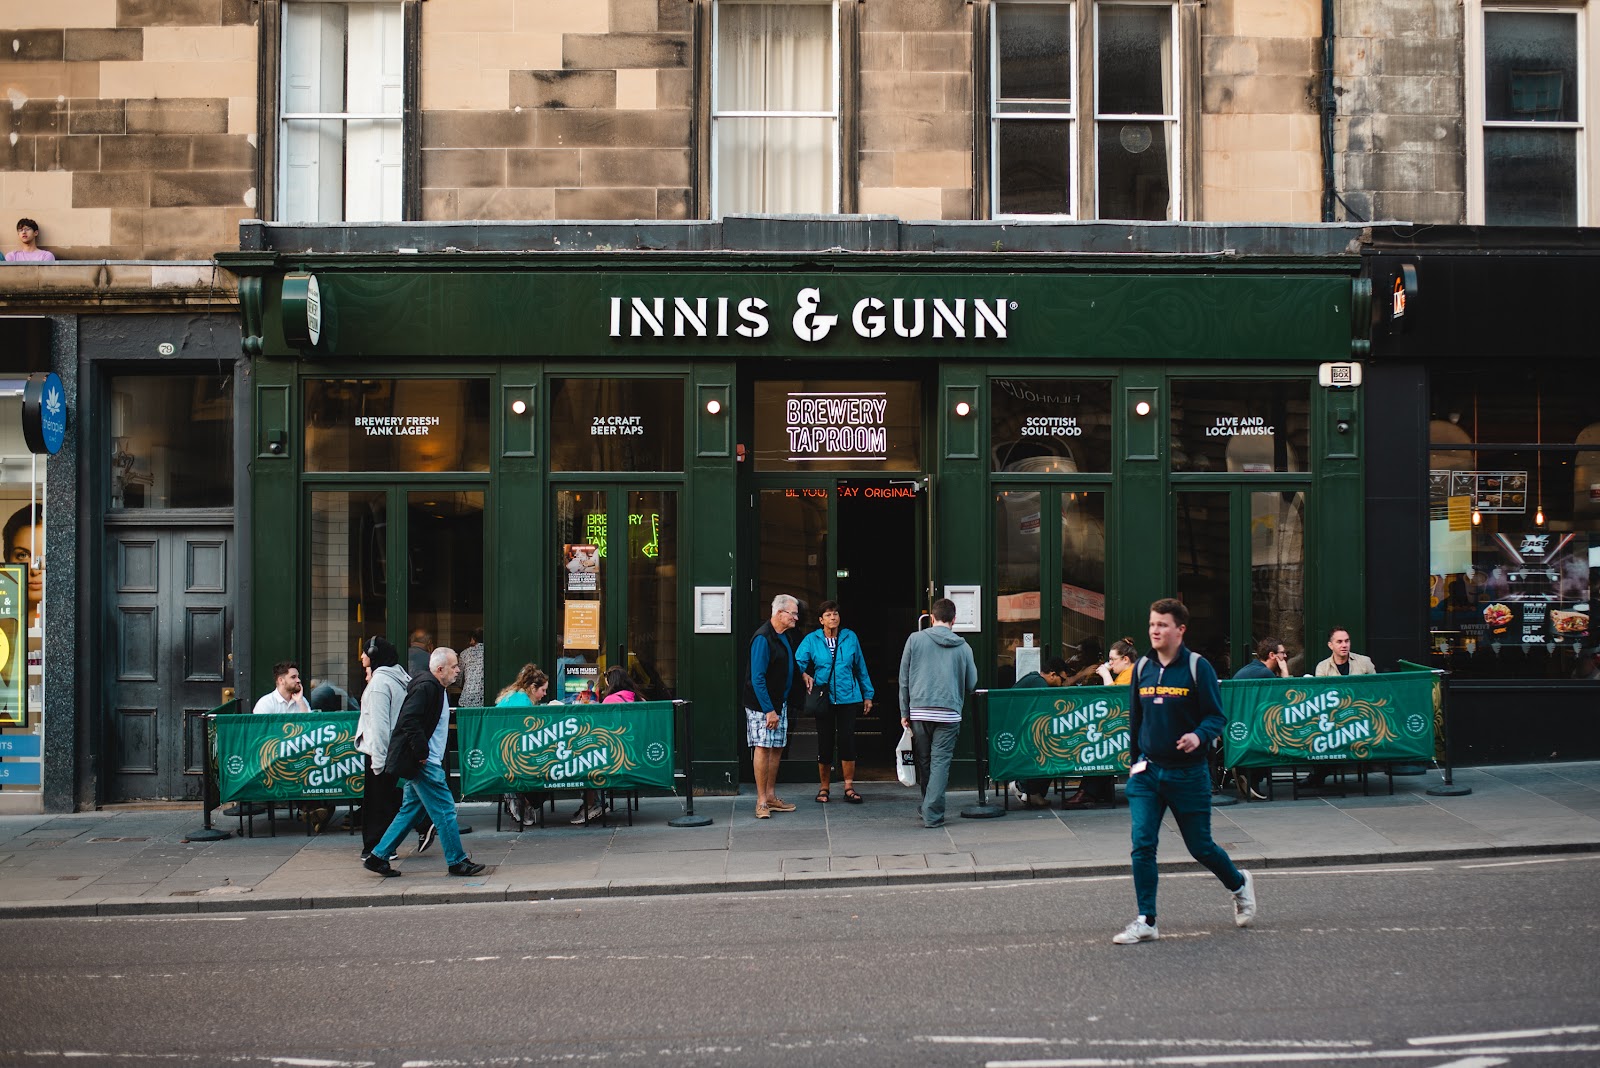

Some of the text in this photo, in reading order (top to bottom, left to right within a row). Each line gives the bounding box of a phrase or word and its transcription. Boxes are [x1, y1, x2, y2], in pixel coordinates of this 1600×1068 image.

[608, 297, 769, 338] INNIS
[792, 287, 838, 342] &
[161, 345, 172, 354] 79
[787, 399, 887, 424] BREWERY
[354, 416, 440, 426] BREWERY FRESH
[593, 416, 640, 426] 24 CRAFT
[1026, 417, 1076, 426] SCOTTISH
[1216, 417, 1264, 426] LIVE AND
[366, 426, 429, 436] TANK LAGER
[590, 426, 644, 435] BEER TAPS
[786, 426, 886, 452] TAPROOM
[1021, 426, 1082, 436] SOUL FOOD
[1206, 426, 1274, 436] LOCAL MUSIC
[864, 488, 916, 498] ORIGINAL
[4, 598, 11, 606] &
[1156, 686, 1190, 696] SPORT
[1284, 690, 1340, 724] INNIS
[1053, 700, 1108, 734] INNIS
[1318, 714, 1335, 732] &
[280, 724, 336, 758] INNIS
[522, 718, 578, 752] INNIS
[1086, 724, 1102, 742] &
[1313, 719, 1370, 753] GUNN
[314, 747, 330, 766] &
[556, 740, 572, 760] &
[308, 756, 365, 786] GUNN
[550, 747, 607, 780] GUNN
